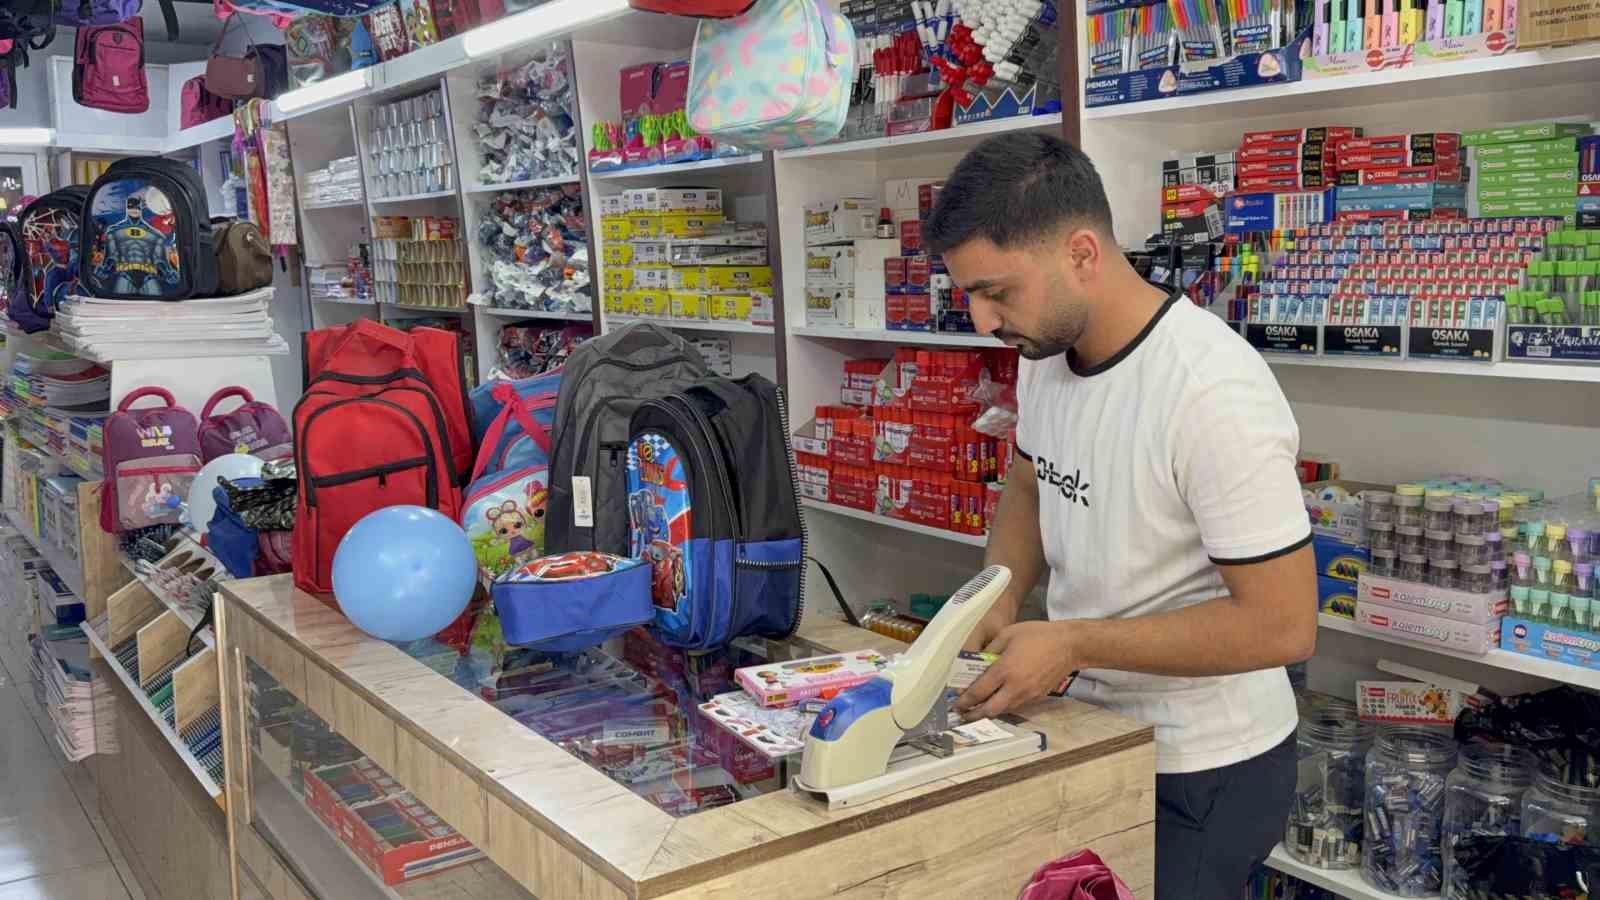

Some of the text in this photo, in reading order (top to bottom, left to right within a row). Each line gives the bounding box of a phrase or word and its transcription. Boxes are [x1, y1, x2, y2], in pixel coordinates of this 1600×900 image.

[1266, 326, 1297, 338] OSAKA
[1344, 327, 1379, 339] OSAKA
[1432, 329, 1469, 342] OSAKA
